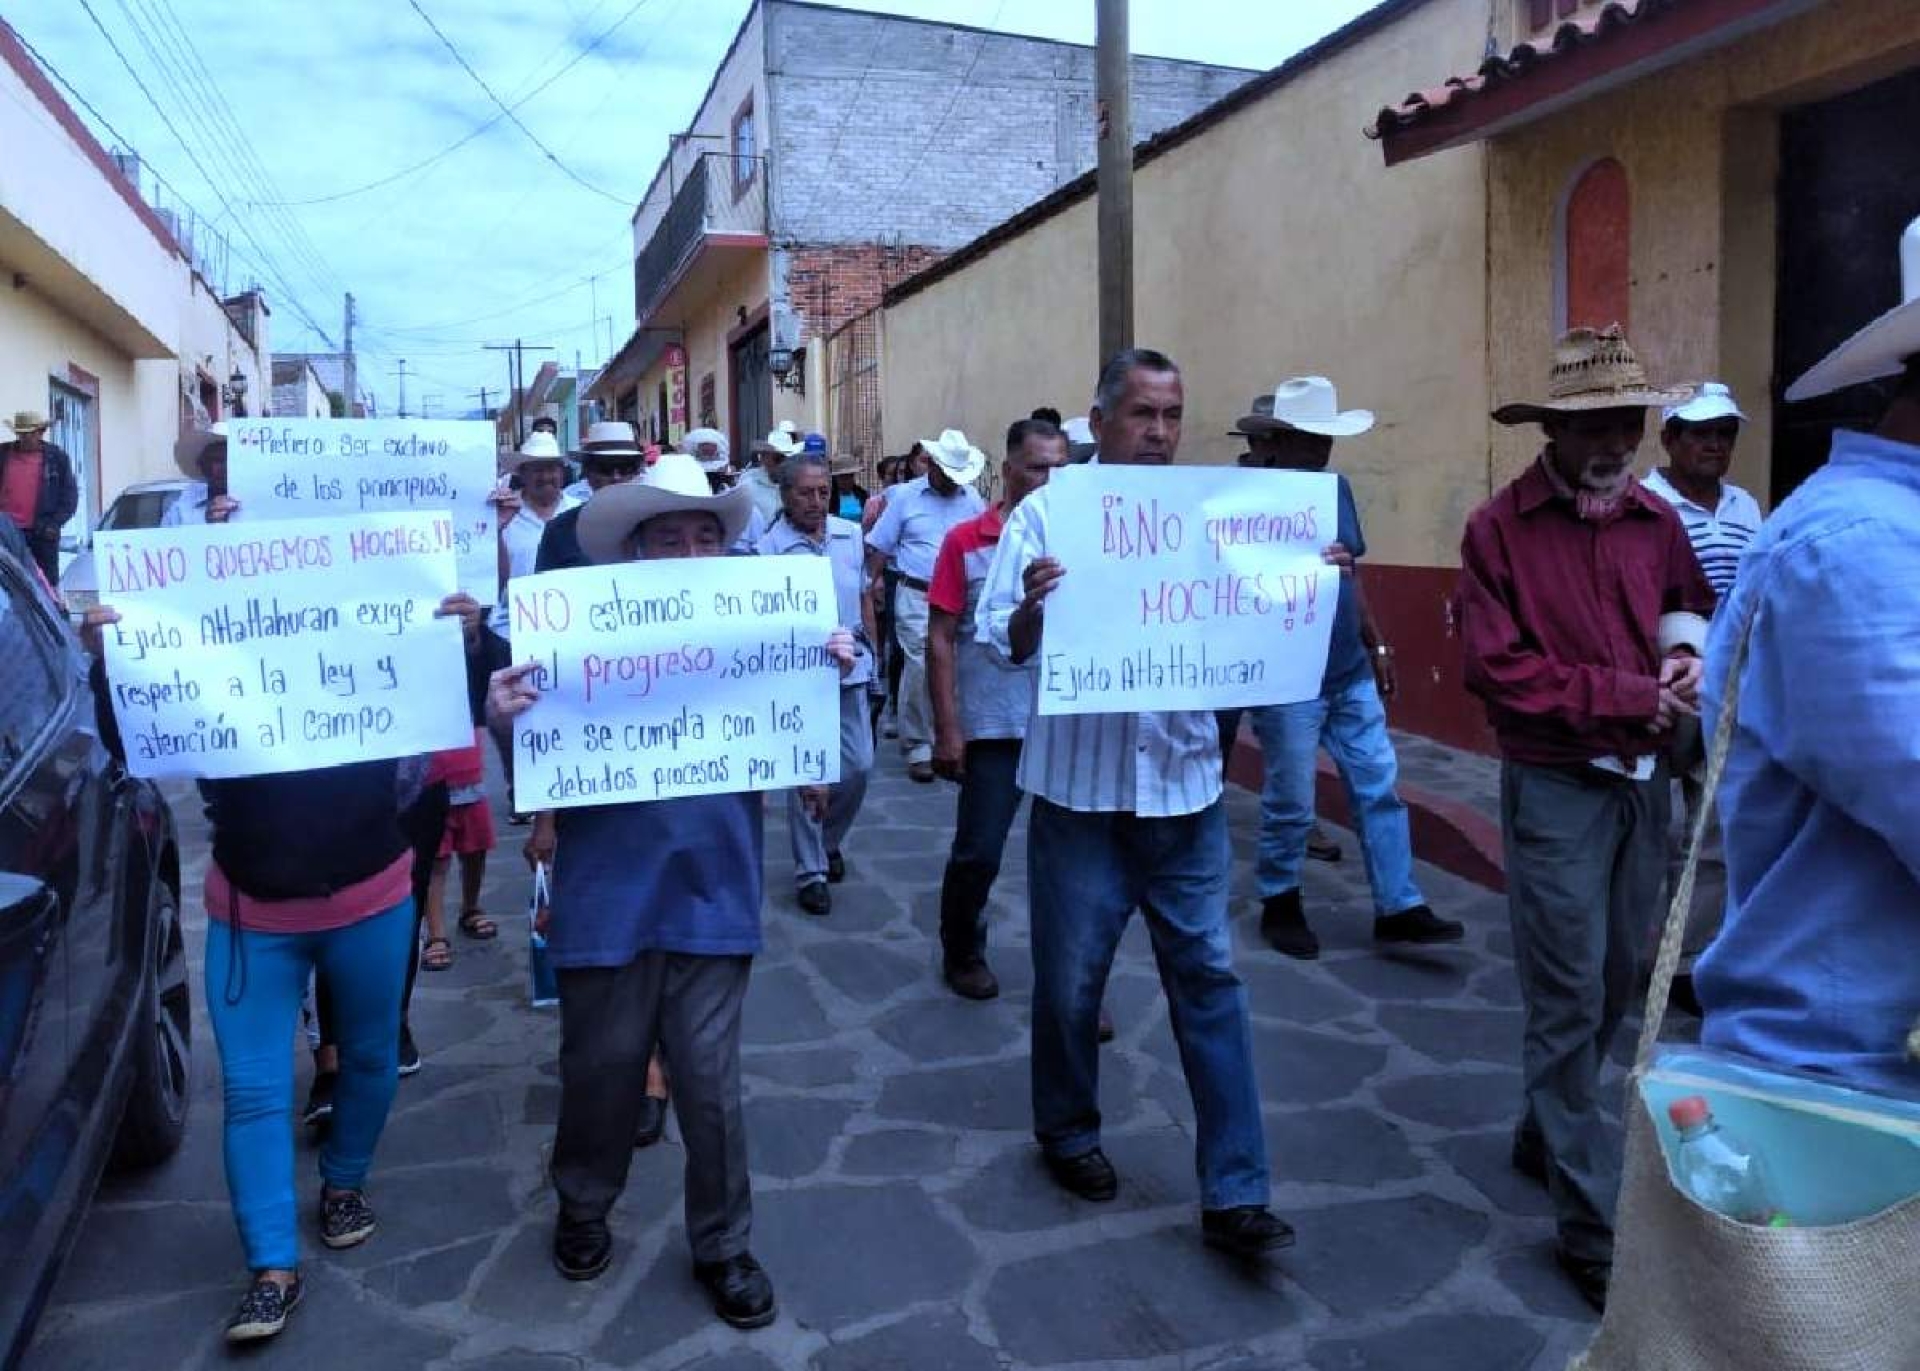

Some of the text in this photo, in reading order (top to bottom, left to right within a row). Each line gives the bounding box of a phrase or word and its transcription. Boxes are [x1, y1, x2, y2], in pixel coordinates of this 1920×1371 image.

[274, 473, 299, 499] de
[314, 474, 342, 500] los
[205, 535, 333, 580] QUEREMOS
[1206, 506, 1316, 562] queremos
[356, 599, 414, 635] exige
[514, 576, 817, 632] NO estamos en contra
[116, 653, 398, 712] respeto a la ley y
[1047, 654, 1111, 701] Ejido
[135, 712, 239, 759] atención
[257, 706, 285, 748] al
[520, 700, 804, 764] que se cumpla con los
[548, 745, 826, 801] debidos procesos por ley
